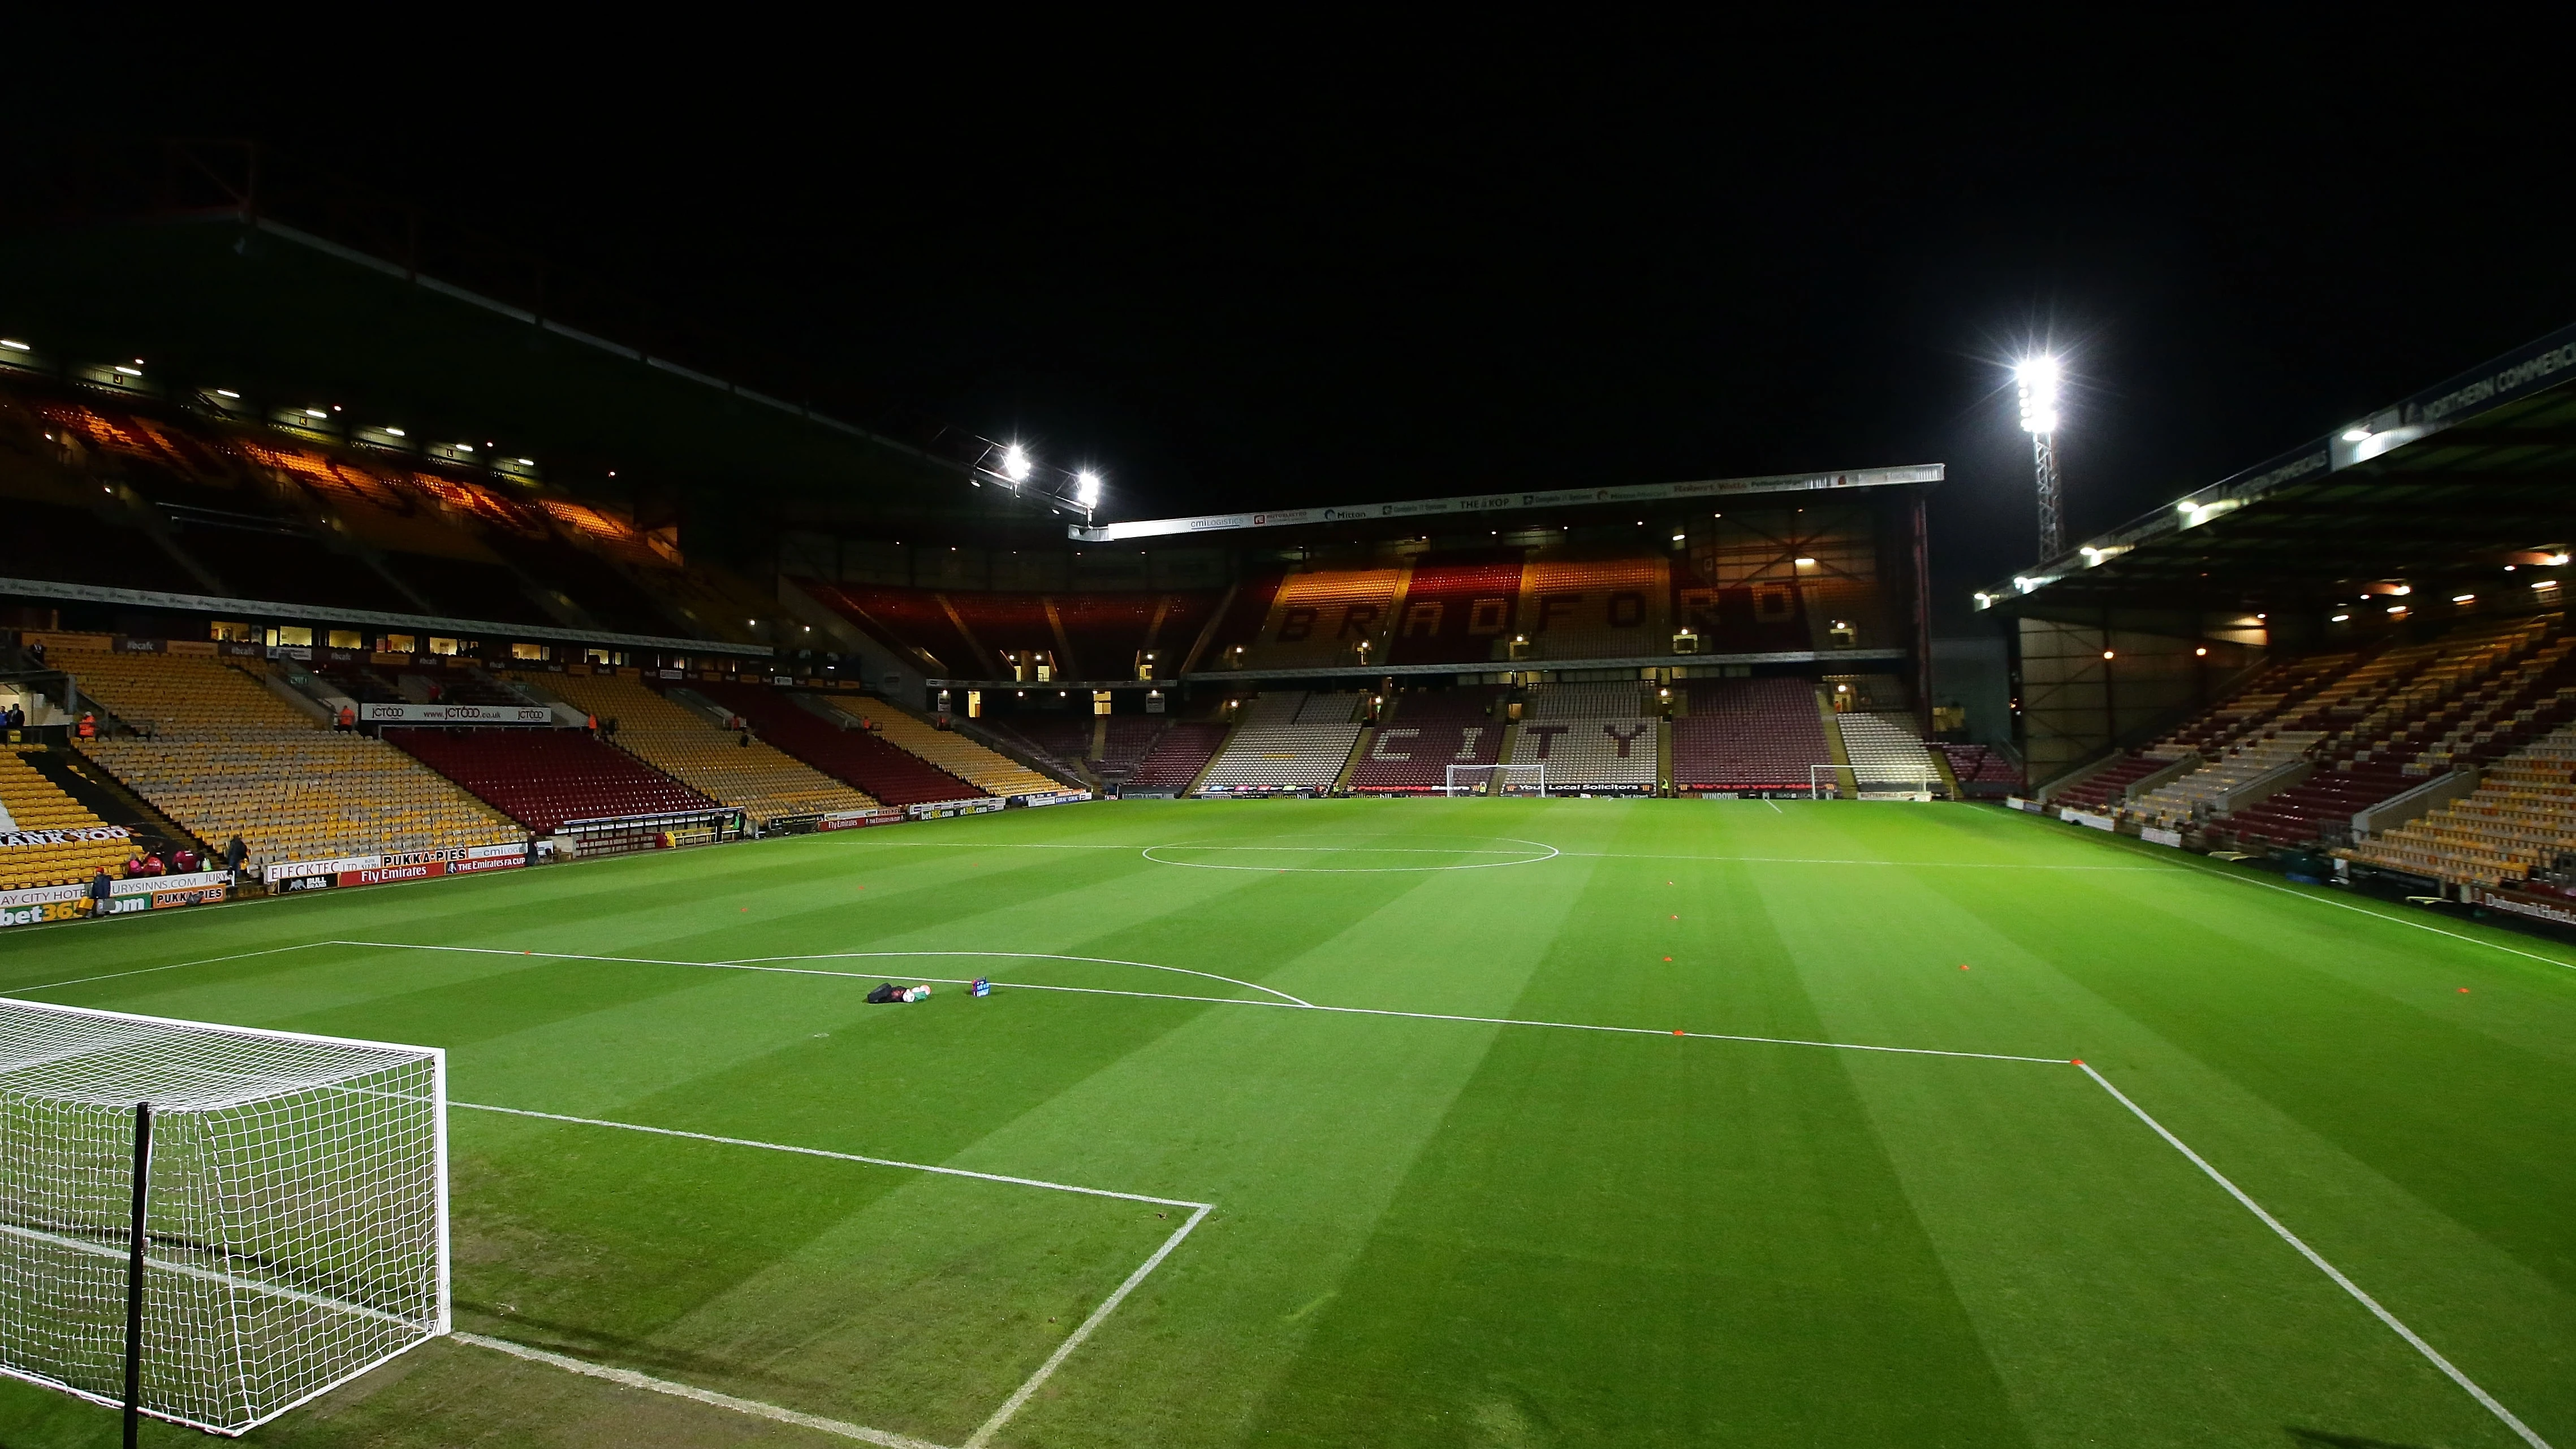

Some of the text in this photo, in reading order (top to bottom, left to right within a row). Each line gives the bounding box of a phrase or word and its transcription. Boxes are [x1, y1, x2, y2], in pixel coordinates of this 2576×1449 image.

[1488, 498, 1509, 507] KOP
[1277, 583, 1795, 642] BRADFORD
[1372, 724, 1647, 759] CITY
[71, 827, 130, 841] YOU
[383, 849, 466, 867] PUKKA-PIES
[458, 862, 472, 871] THE
[472, 858, 504, 870] Emirates
[205, 873, 228, 884] JURY
[361, 866, 427, 883] Fly Emirates
[112, 877, 197, 895] URYSINNS.COM
[21, 892, 49, 903] CITY
[0, 898, 146, 927] bet36om
